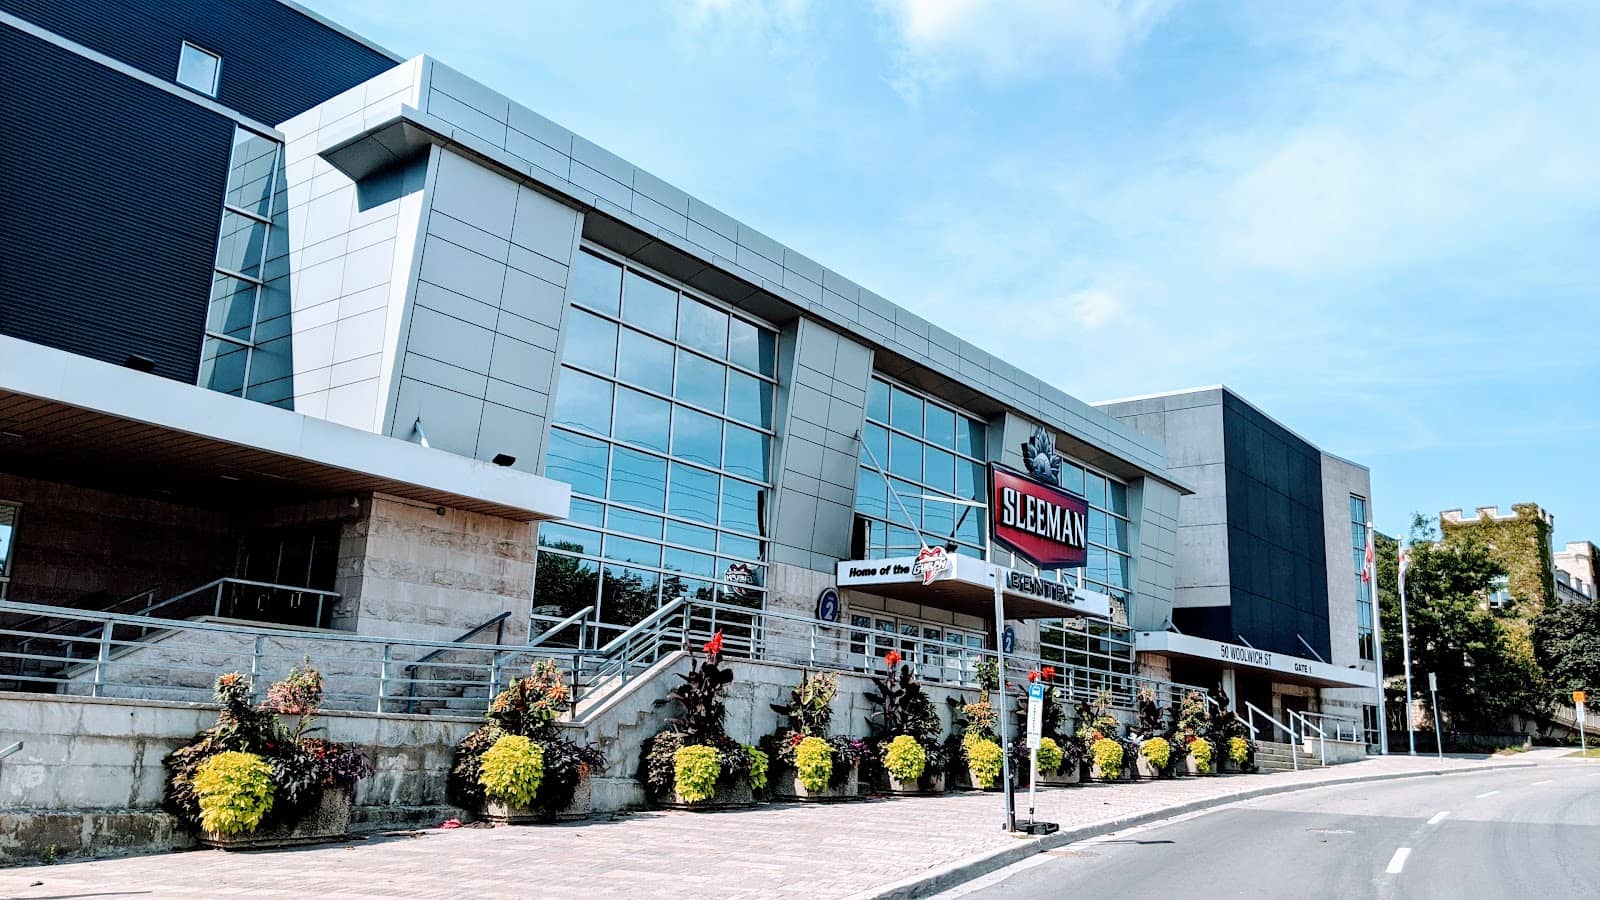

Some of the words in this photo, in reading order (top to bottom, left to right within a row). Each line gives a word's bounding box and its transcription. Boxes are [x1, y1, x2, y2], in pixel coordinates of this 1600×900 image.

[1003, 487, 1085, 549] SLEEMAN
[849, 567, 877, 578] Home
[880, 565, 892, 576] of
[893, 564, 910, 575] the
[1009, 571, 1075, 604] CENTRE
[824, 601, 834, 620] 2
[1005, 637, 1011, 652] 2
[1221, 645, 1229, 659] 50
[1230, 647, 1263, 664] WOOLWICH
[1264, 653, 1272, 666] ST
[1294, 663, 1308, 673] GATE
